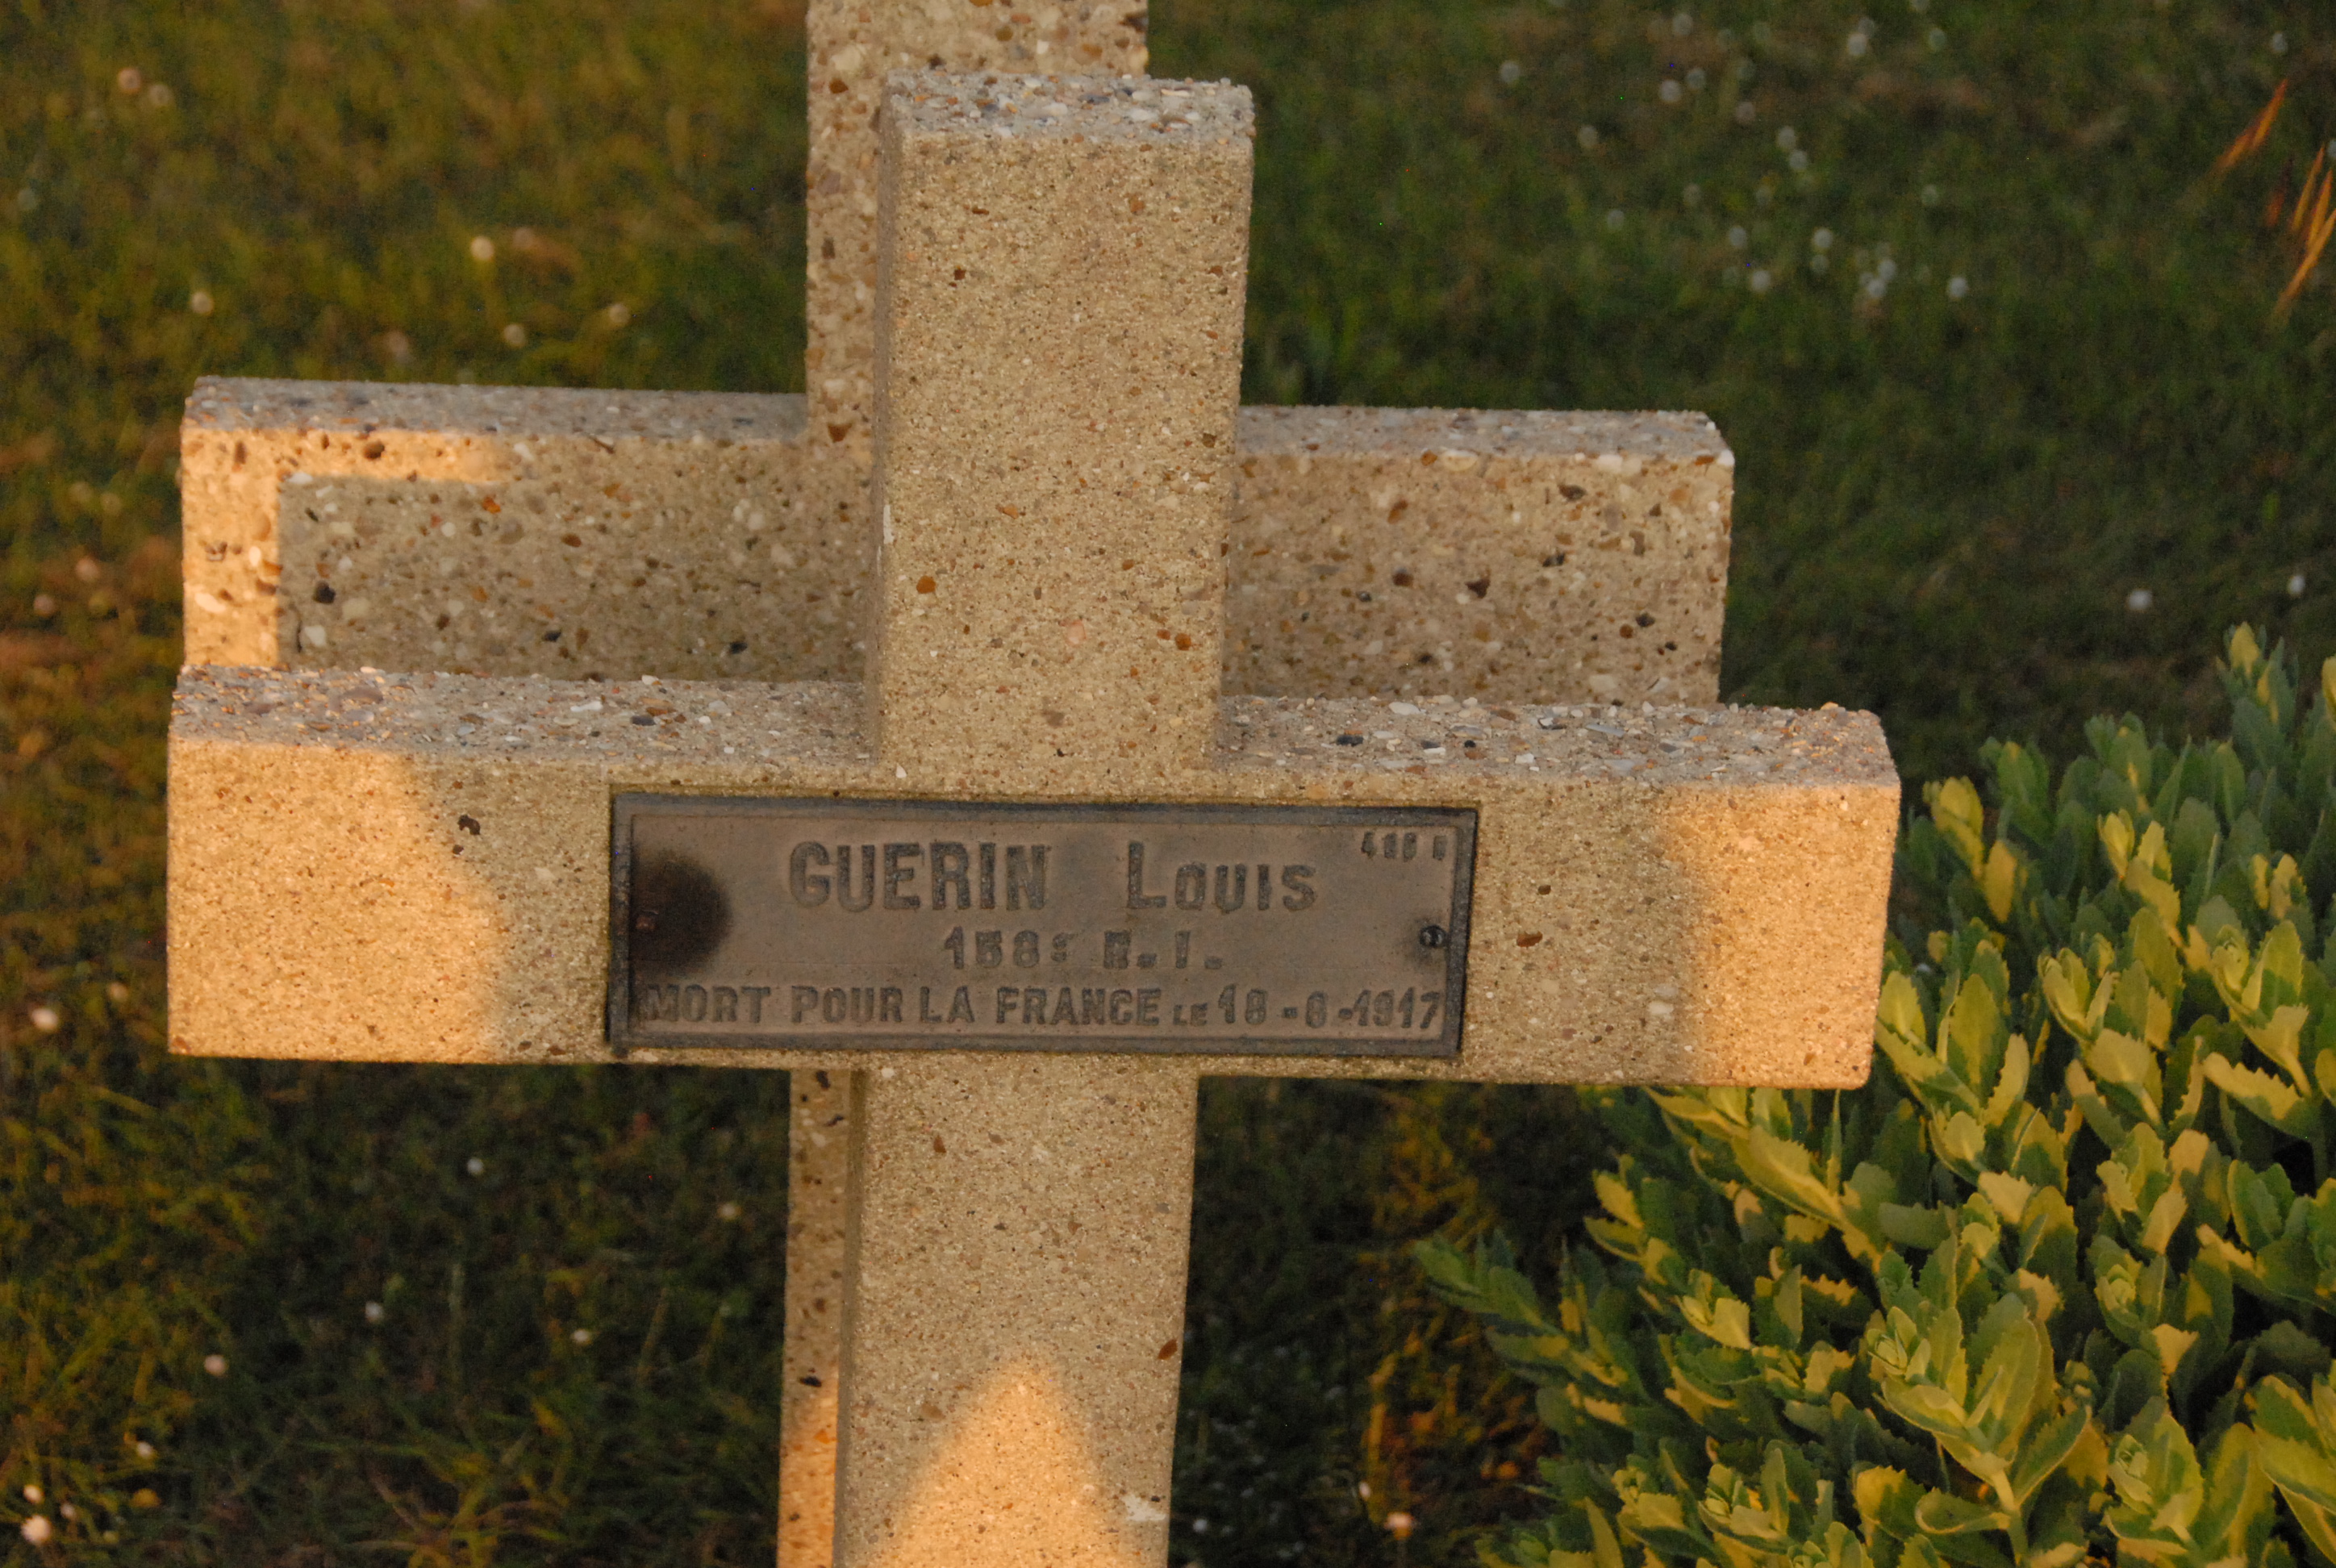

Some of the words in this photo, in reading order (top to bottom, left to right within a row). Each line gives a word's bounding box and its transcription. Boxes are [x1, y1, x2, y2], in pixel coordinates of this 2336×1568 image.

[788, 840, 1049, 912] GUERIN
[643, 983, 771, 1023] MORT
[791, 985, 903, 1024] POUR
[920, 986, 975, 1024] LA
[996, 986, 1162, 1026] FRANCE
